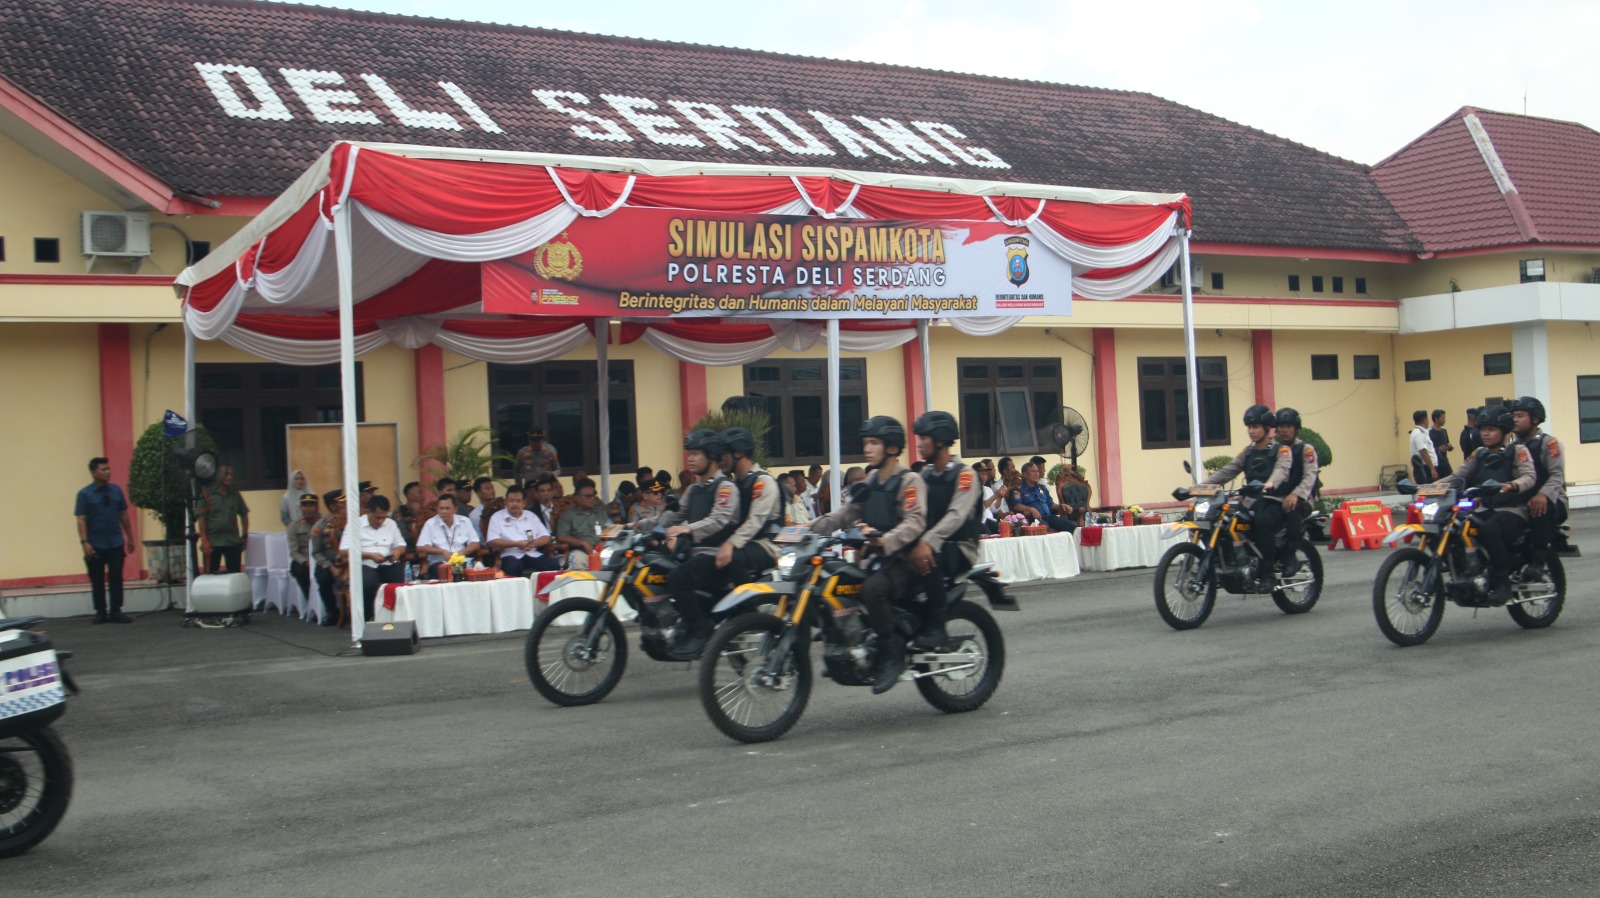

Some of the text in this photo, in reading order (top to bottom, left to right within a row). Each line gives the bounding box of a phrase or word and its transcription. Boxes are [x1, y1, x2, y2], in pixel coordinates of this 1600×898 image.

[194, 62, 1012, 169] DELI SERDANG
[668, 218, 945, 263] SIMULASI SISPAMKOTA
[667, 263, 947, 286] POLRESTA DELI SERDANG
[619, 292, 978, 314] Berintegritas dan Humanis dalam Melayani Masyarakat
